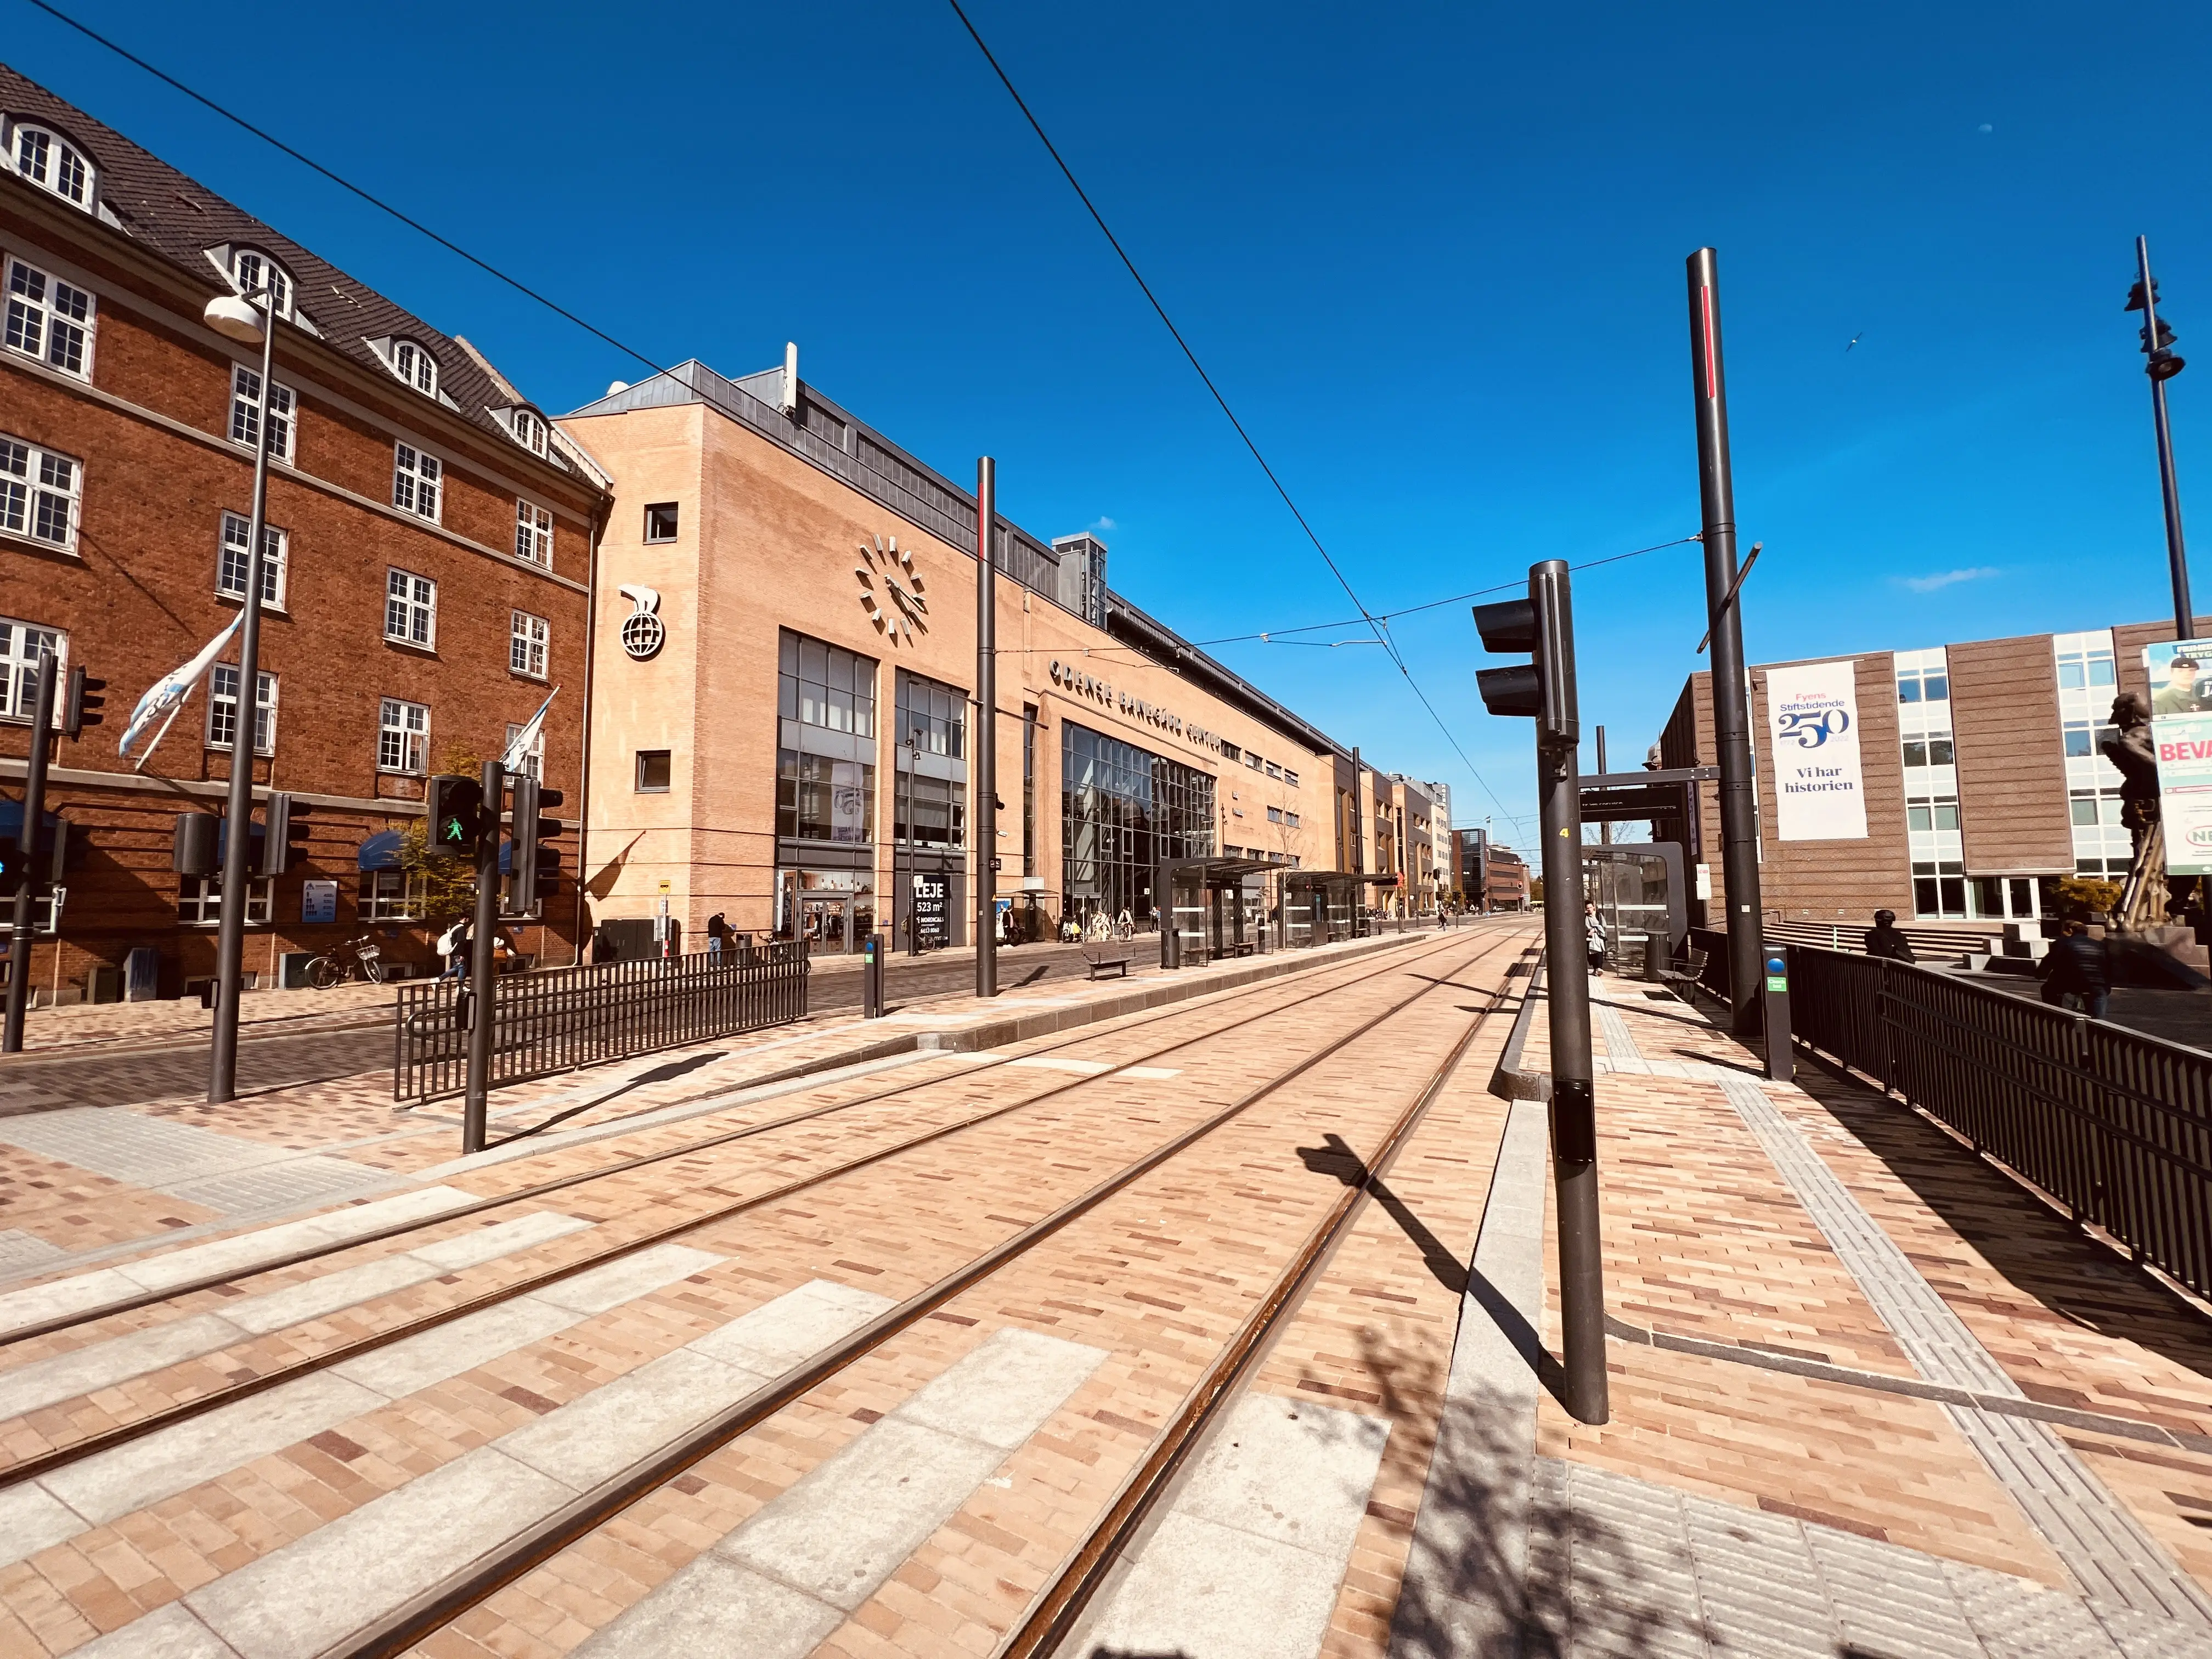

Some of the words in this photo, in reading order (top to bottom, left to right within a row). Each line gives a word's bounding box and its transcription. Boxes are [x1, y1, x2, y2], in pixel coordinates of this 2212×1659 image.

[1049, 658, 1113, 699] ODENSE
[1796, 693, 1826, 702] Fyens
[1780, 699, 1845, 712] Stiftstidende
[1778, 709, 1849, 748] 250
[1796, 767, 1812, 778] Vi
[1815, 767, 1842, 777] har
[1785, 781, 1853, 793] historien
[1559, 828, 1569, 837] 4
[916, 883, 944, 898] LEJE
[917, 902, 932, 912] 523
